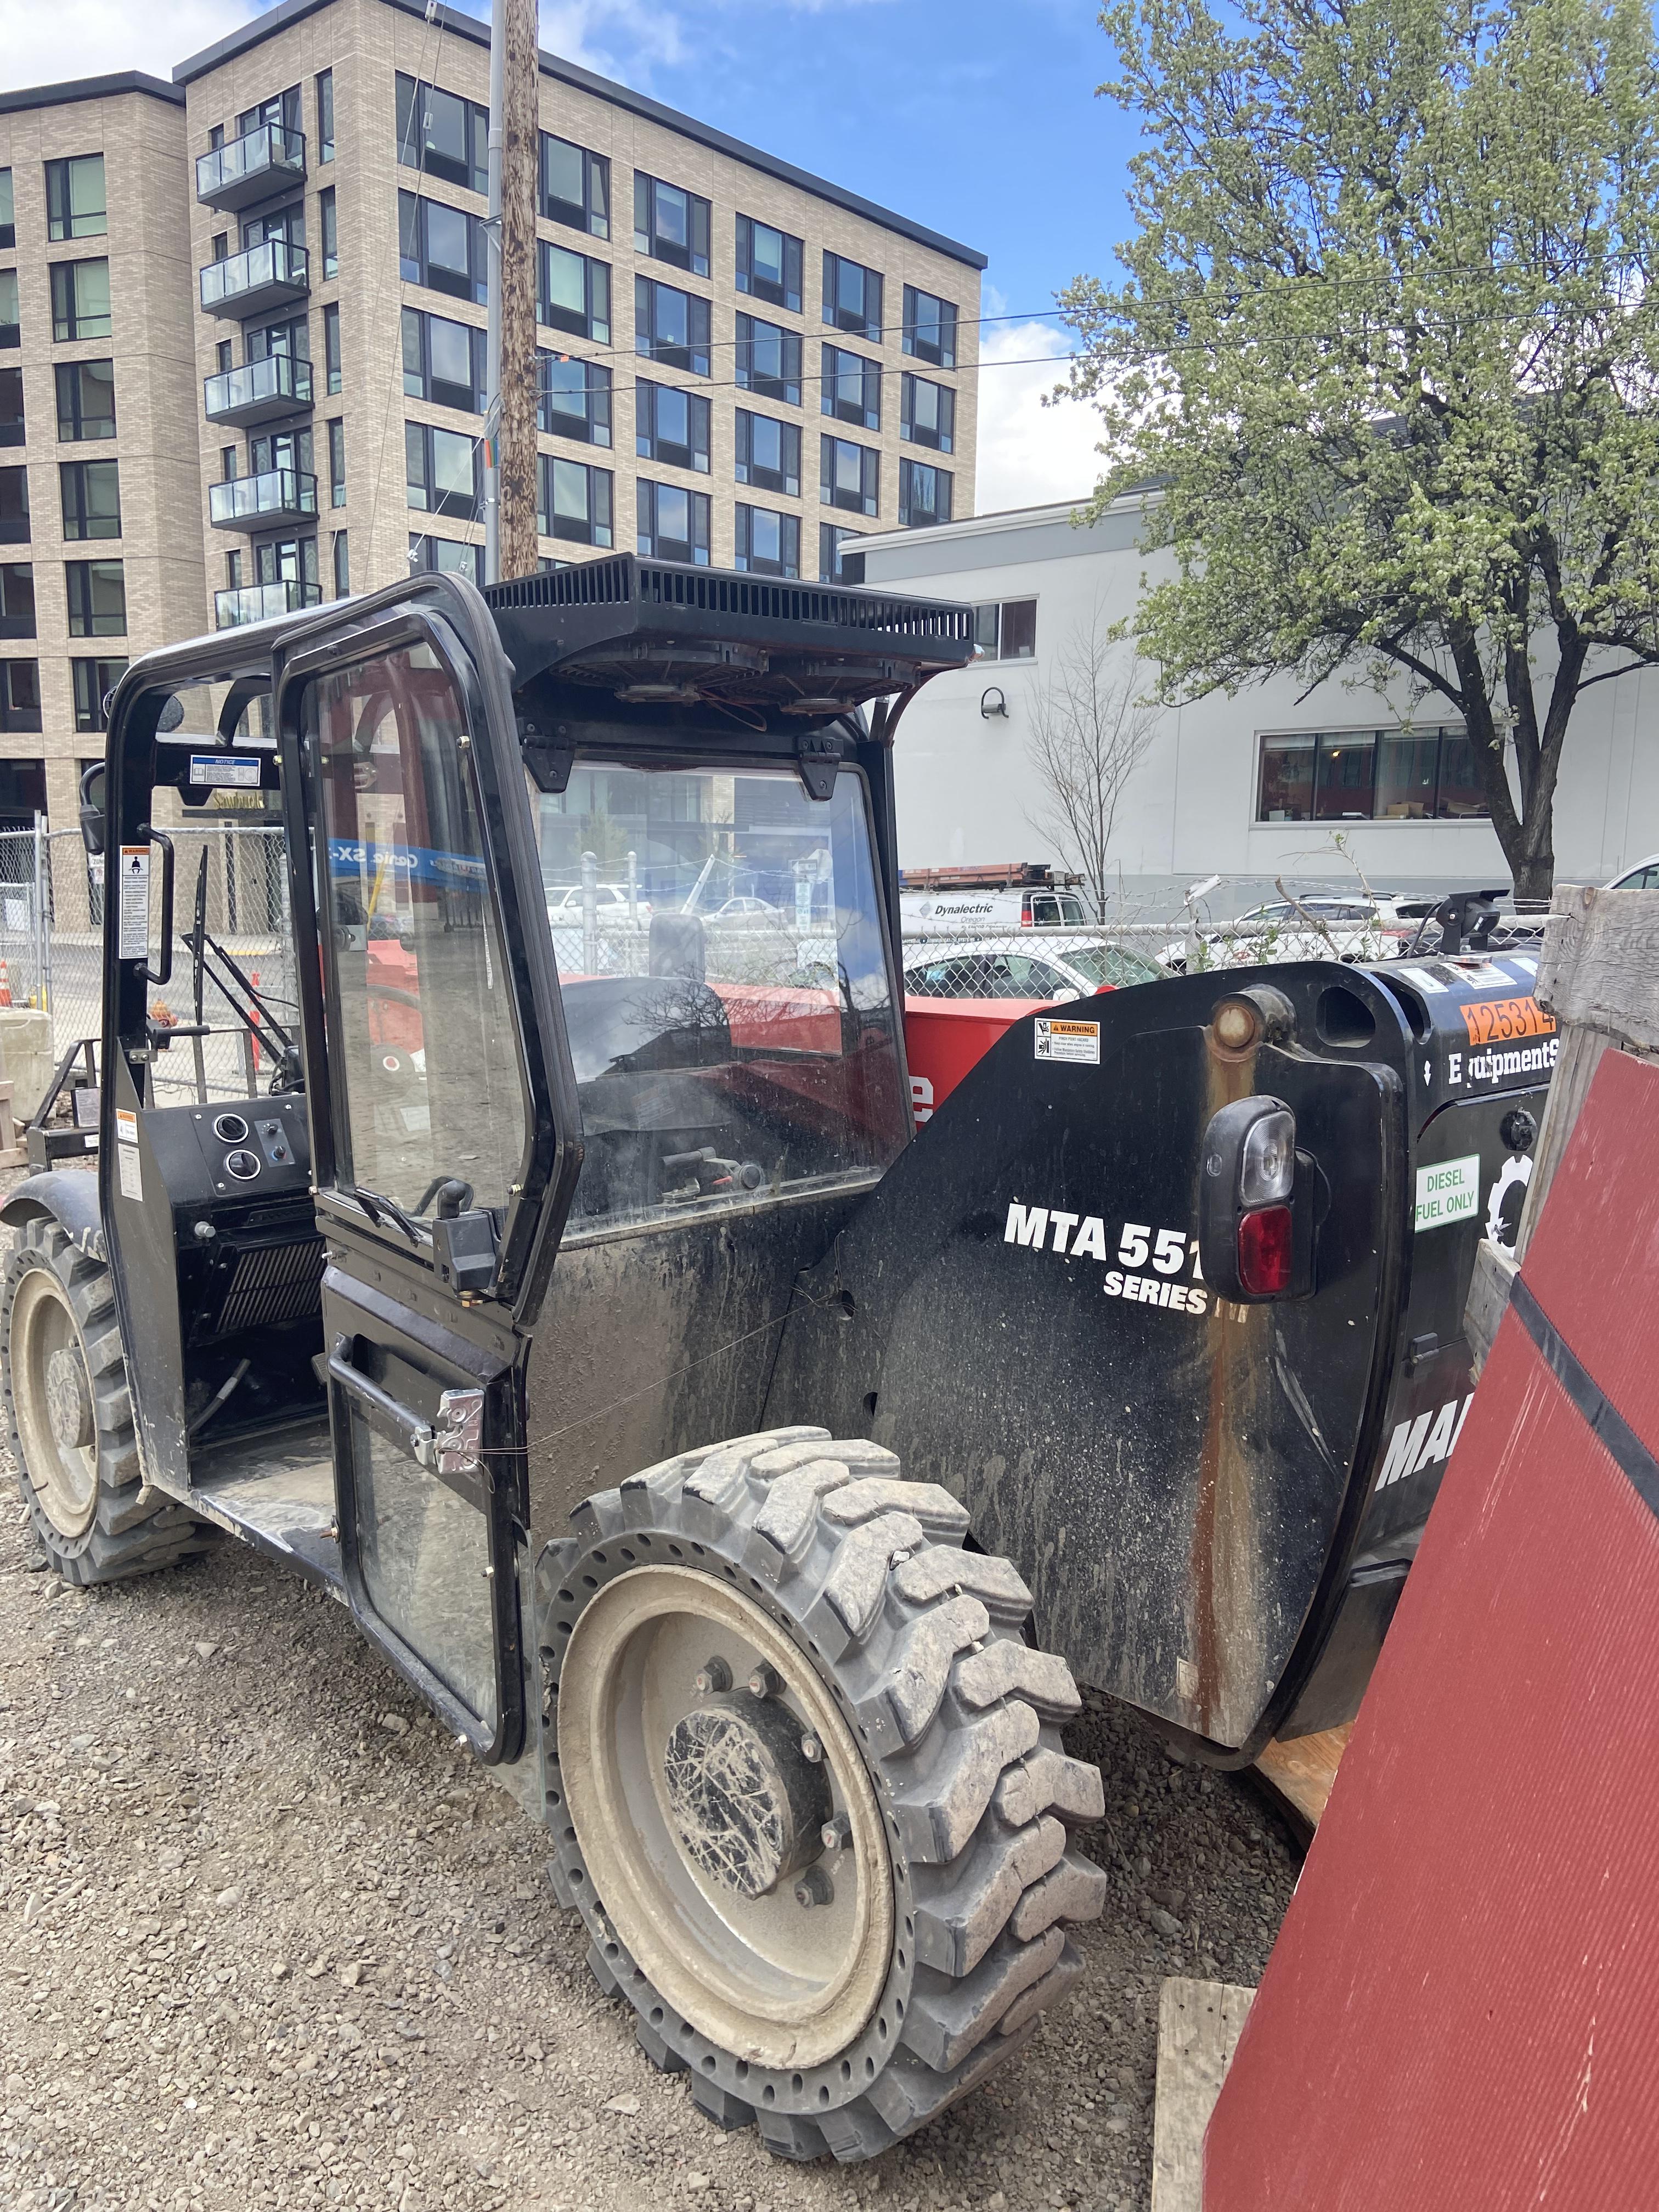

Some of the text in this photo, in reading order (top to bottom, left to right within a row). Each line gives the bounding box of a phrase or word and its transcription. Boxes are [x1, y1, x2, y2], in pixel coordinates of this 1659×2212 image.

[934, 903, 994, 917] Dynalectric
[1060, 1024, 1095, 1034] WARNING
[1427, 1169, 1465, 1192] DIESEL
[1416, 1190, 1475, 1222] FUEL ONLY
[1003, 1203, 1107, 1261] MTA
[1103, 1271, 1207, 1314] SERIES
[1374, 1392, 1476, 1492] MA
